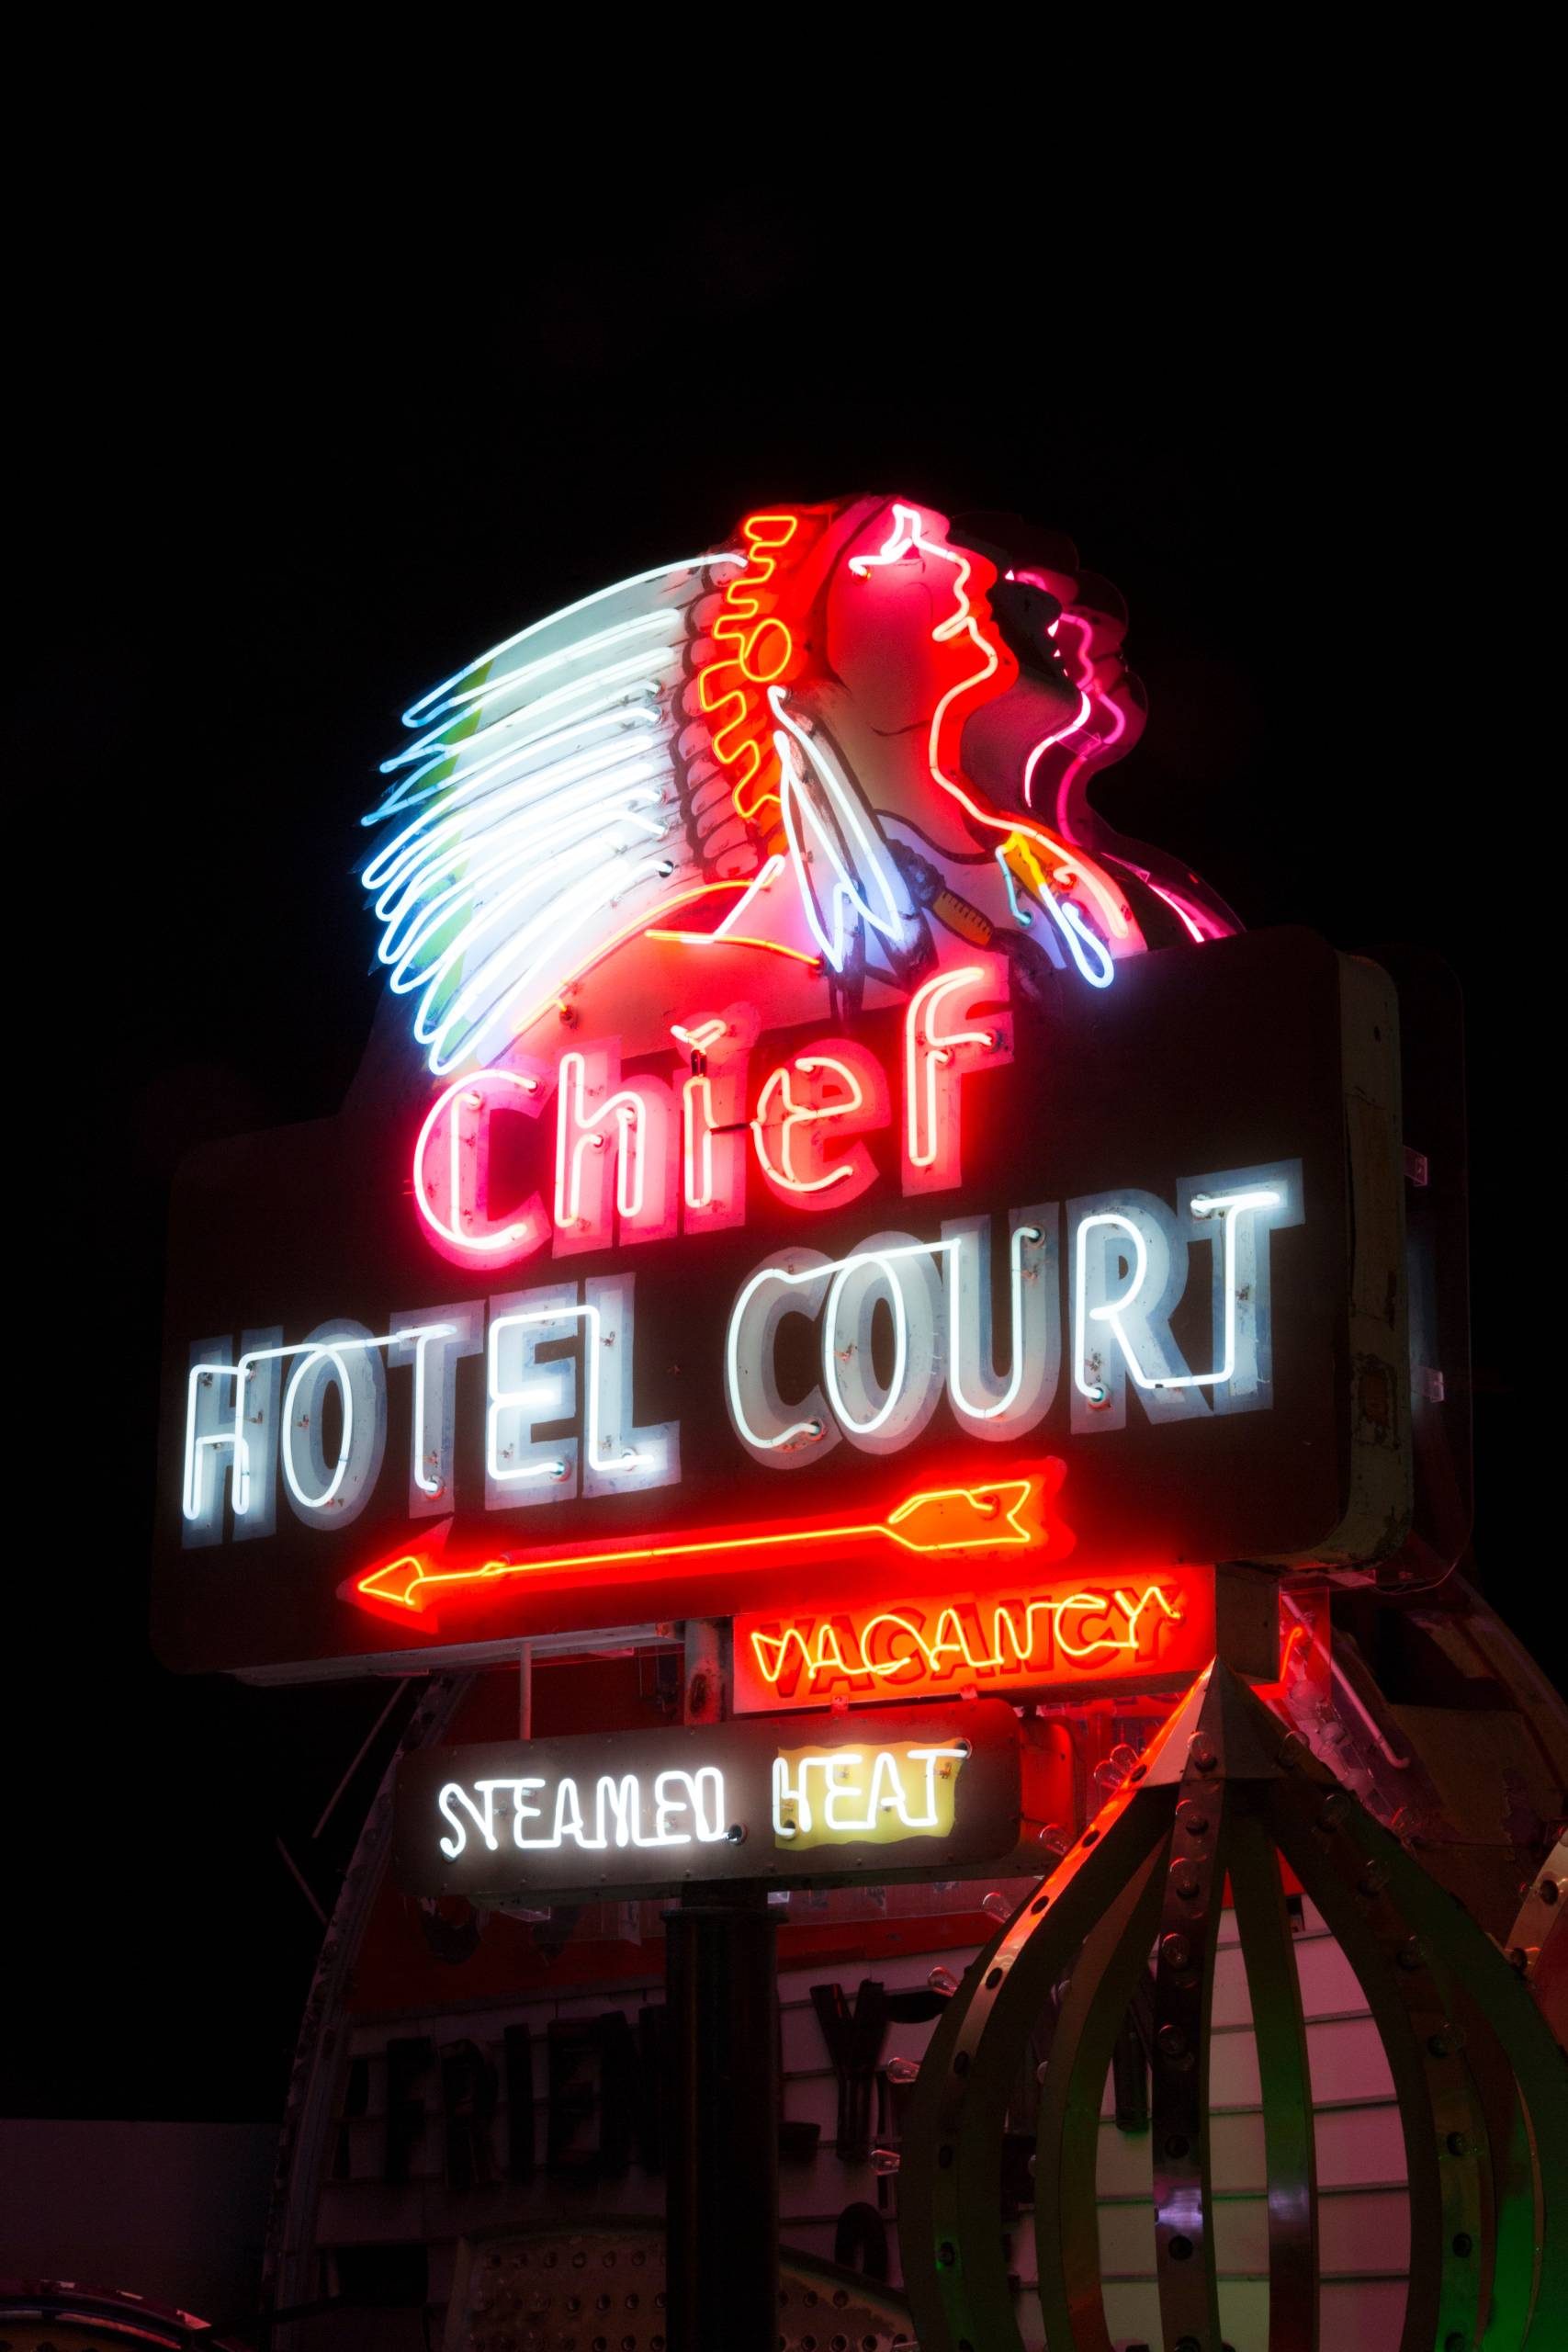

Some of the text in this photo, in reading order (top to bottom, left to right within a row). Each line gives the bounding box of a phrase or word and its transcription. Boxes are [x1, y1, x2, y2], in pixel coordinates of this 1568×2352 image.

[412, 957, 1015, 1271] Chief
[181, 1158, 1306, 1550] HOTEL COURT
[750, 1585, 1185, 1700] VACANCY
[437, 1746, 969, 1860] STEAMED HEAT
